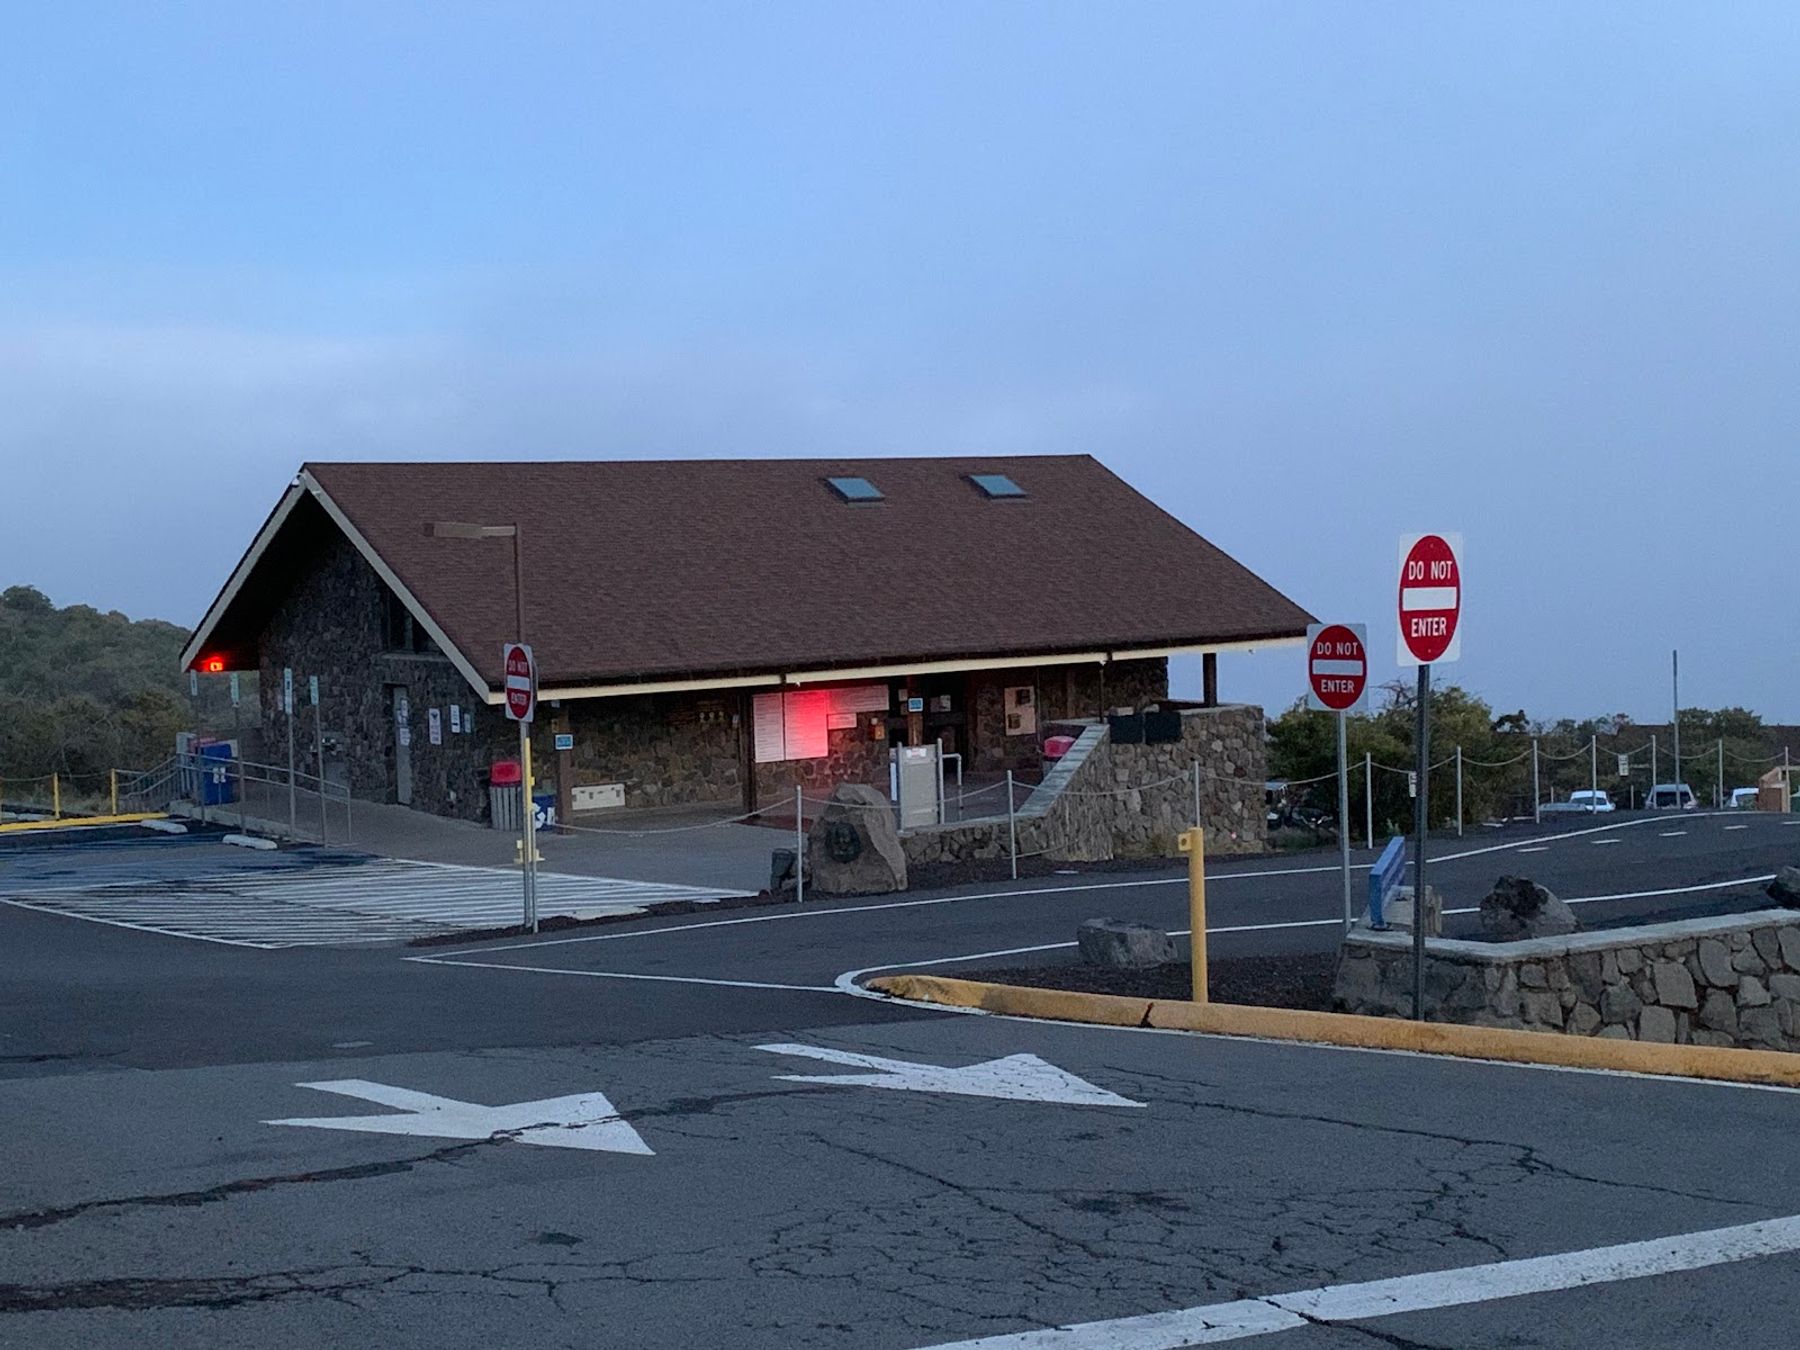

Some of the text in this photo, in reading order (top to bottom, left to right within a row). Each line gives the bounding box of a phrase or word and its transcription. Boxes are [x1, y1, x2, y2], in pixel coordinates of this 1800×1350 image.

[1408, 560, 1453, 581] DO NOT
[1411, 617, 1447, 638] ENTER
[1316, 641, 1358, 656] DO NOT
[1320, 679, 1355, 694] ENTER
